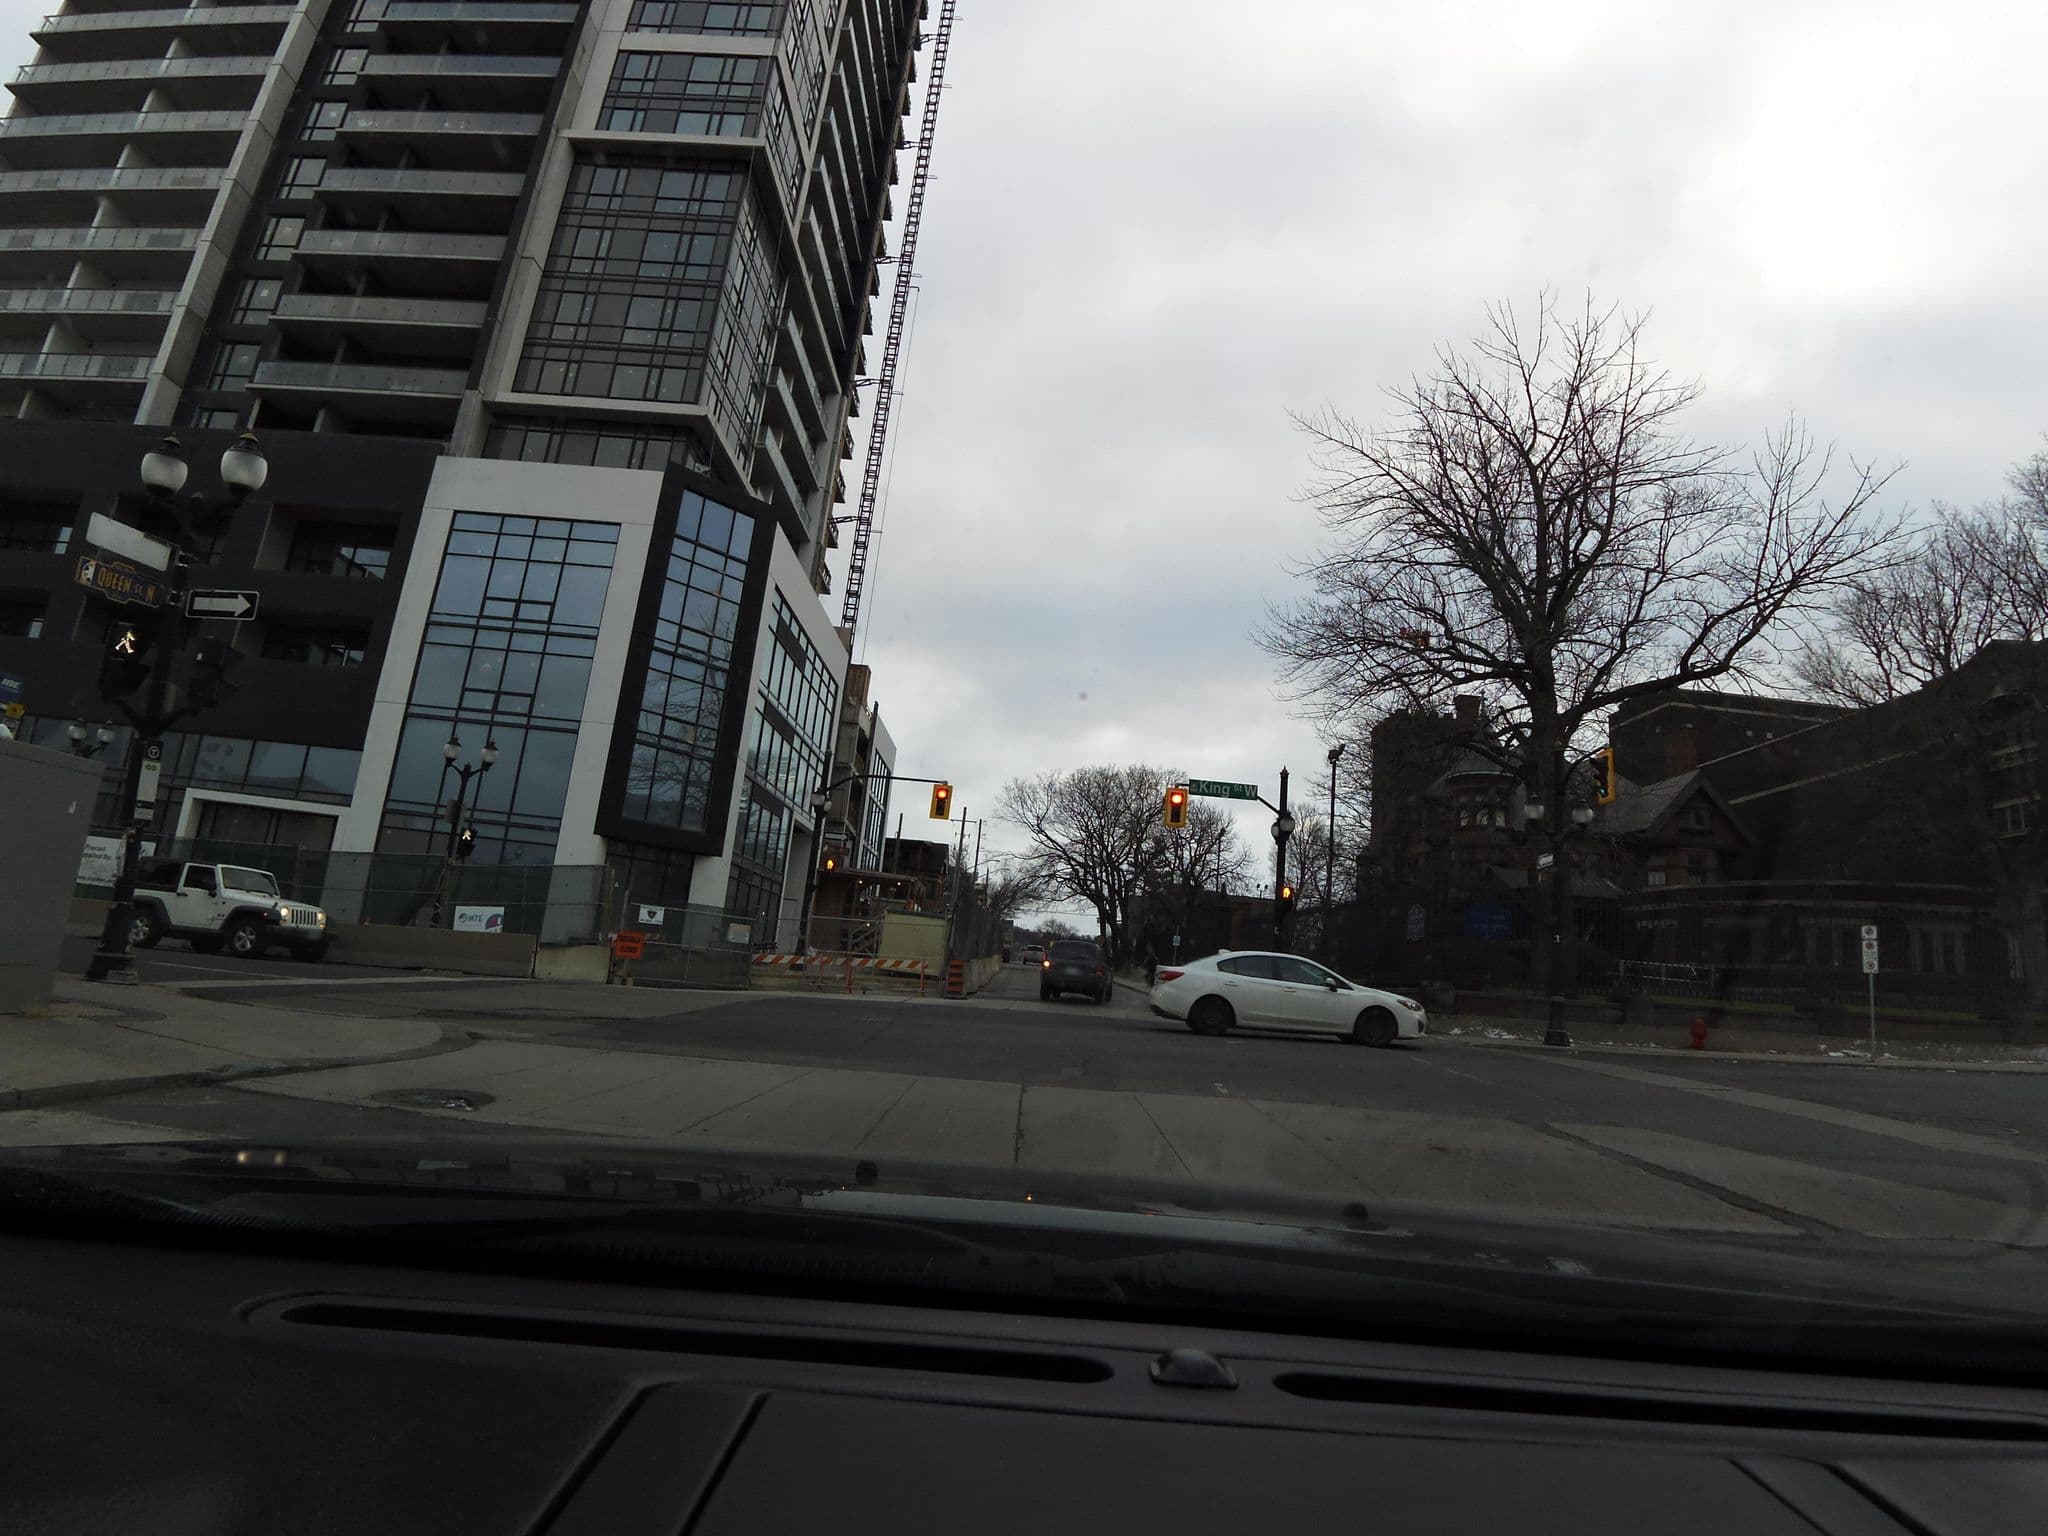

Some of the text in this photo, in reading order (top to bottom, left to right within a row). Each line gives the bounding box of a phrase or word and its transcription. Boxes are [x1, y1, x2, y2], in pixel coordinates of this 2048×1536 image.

[98, 568, 133, 592] QUEEN
[1200, 782, 1230, 798] King
[1245, 786, 1256, 797] W
[469, 915, 483, 923] MTE
